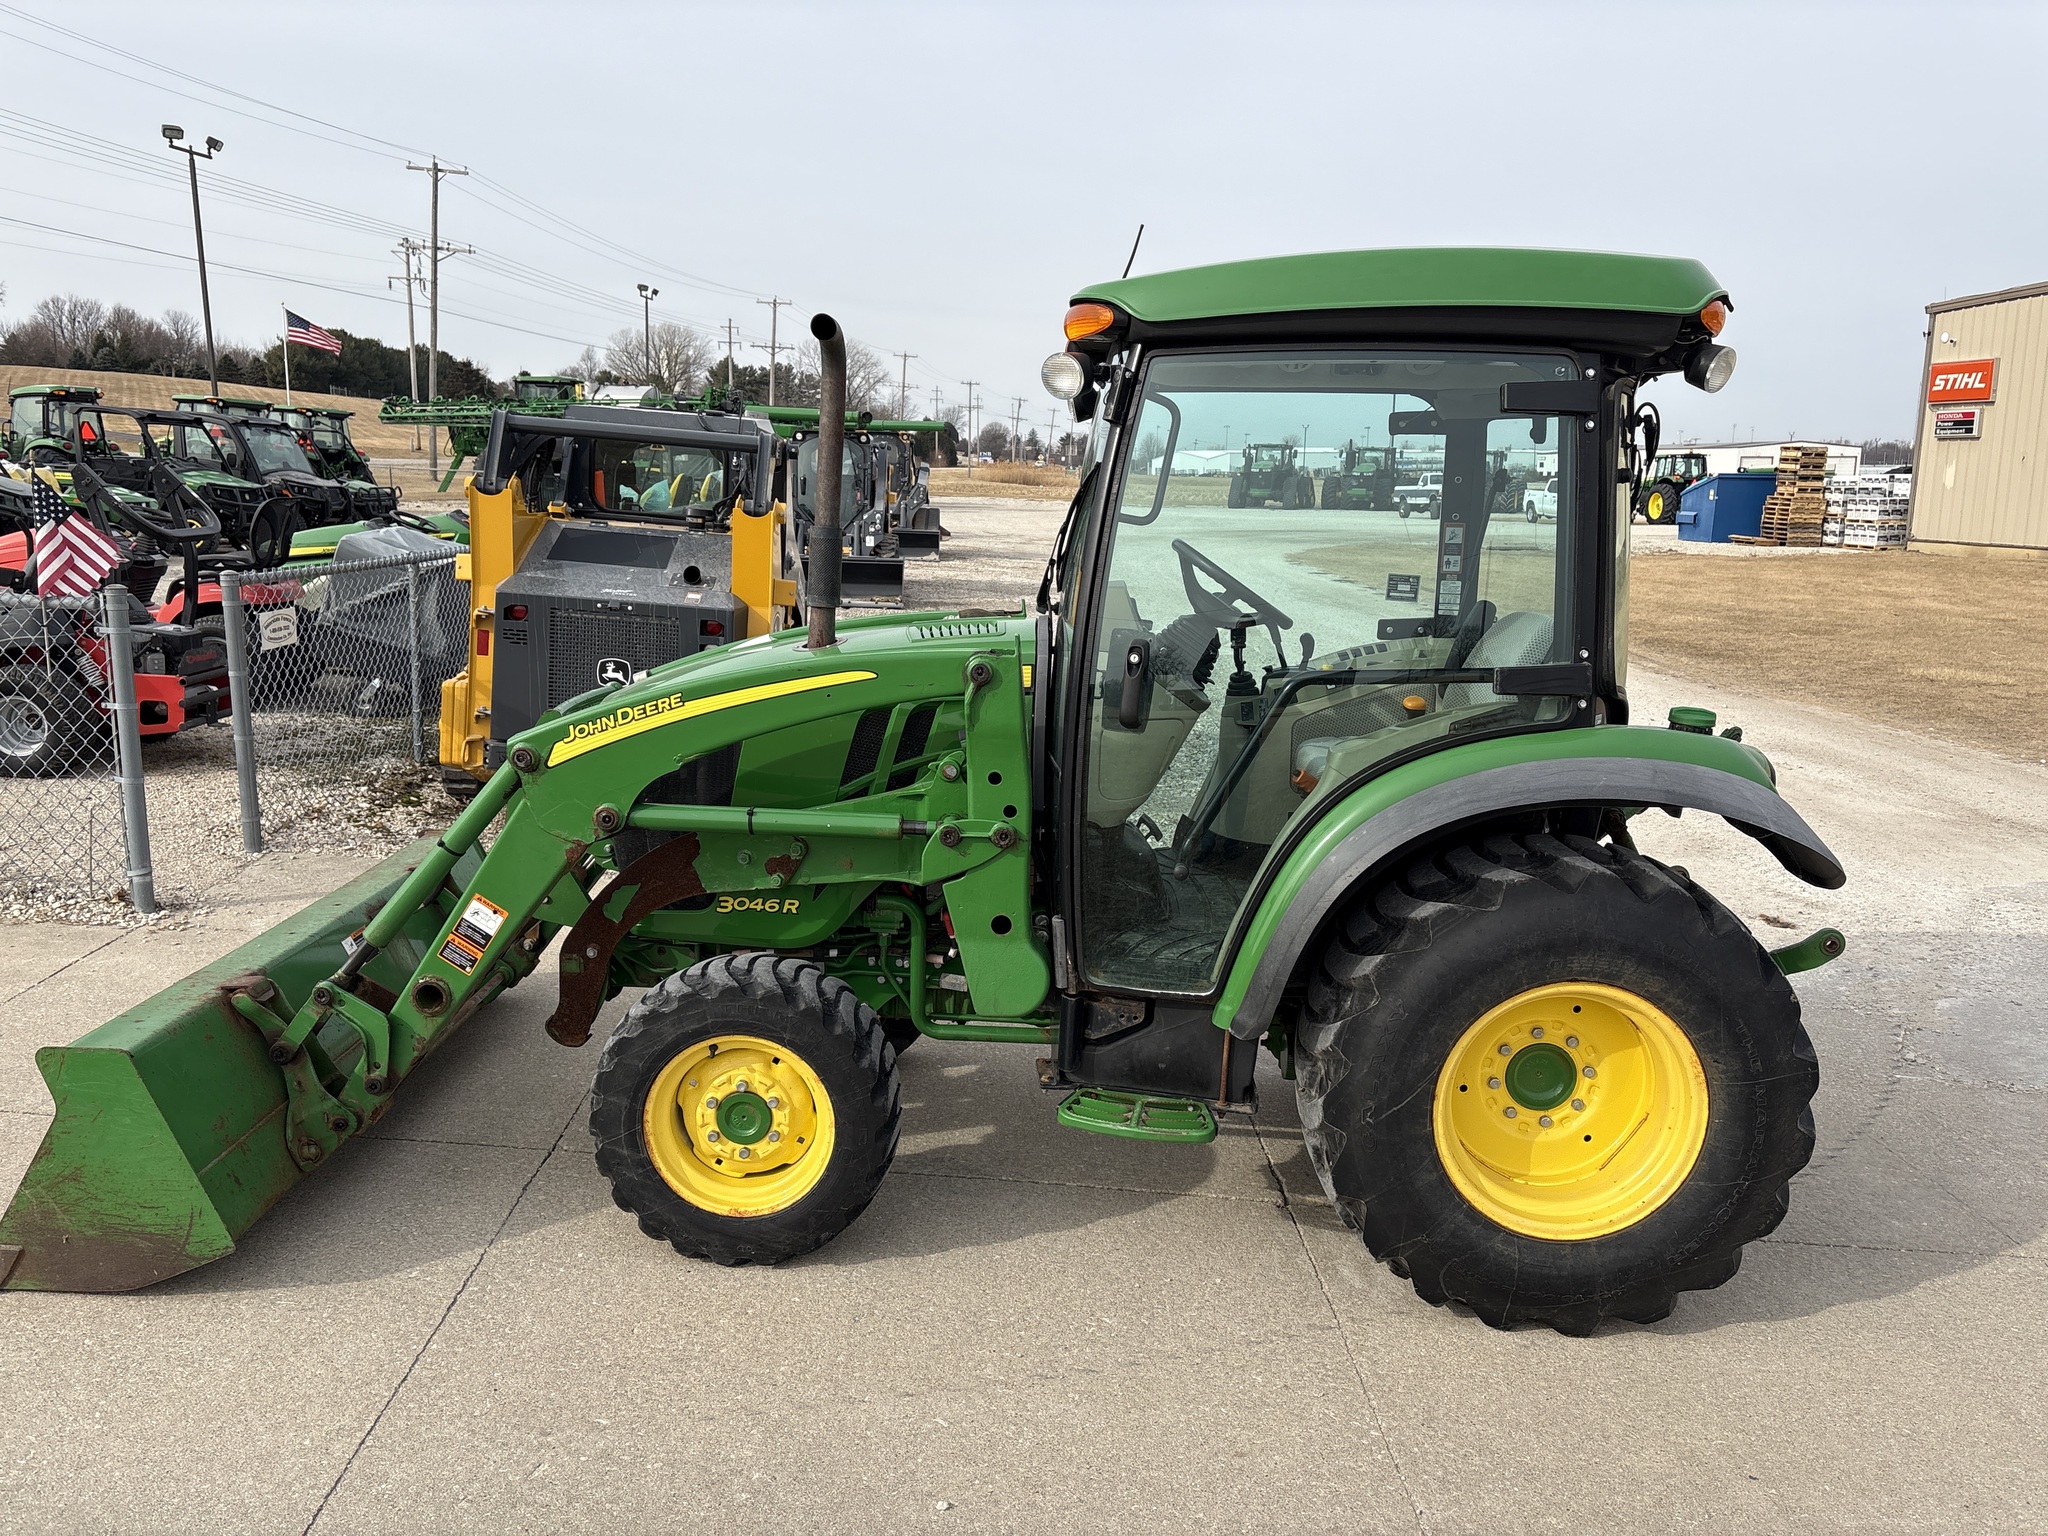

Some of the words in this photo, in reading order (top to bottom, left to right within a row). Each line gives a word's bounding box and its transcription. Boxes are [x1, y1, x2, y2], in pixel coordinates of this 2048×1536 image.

[1932, 372, 1986, 391] STIHL
[563, 714, 616, 743] JOHN
[616, 692, 684, 727] DEERE
[482, 898, 504, 916] WARNING
[457, 939, 479, 957] WARNING
